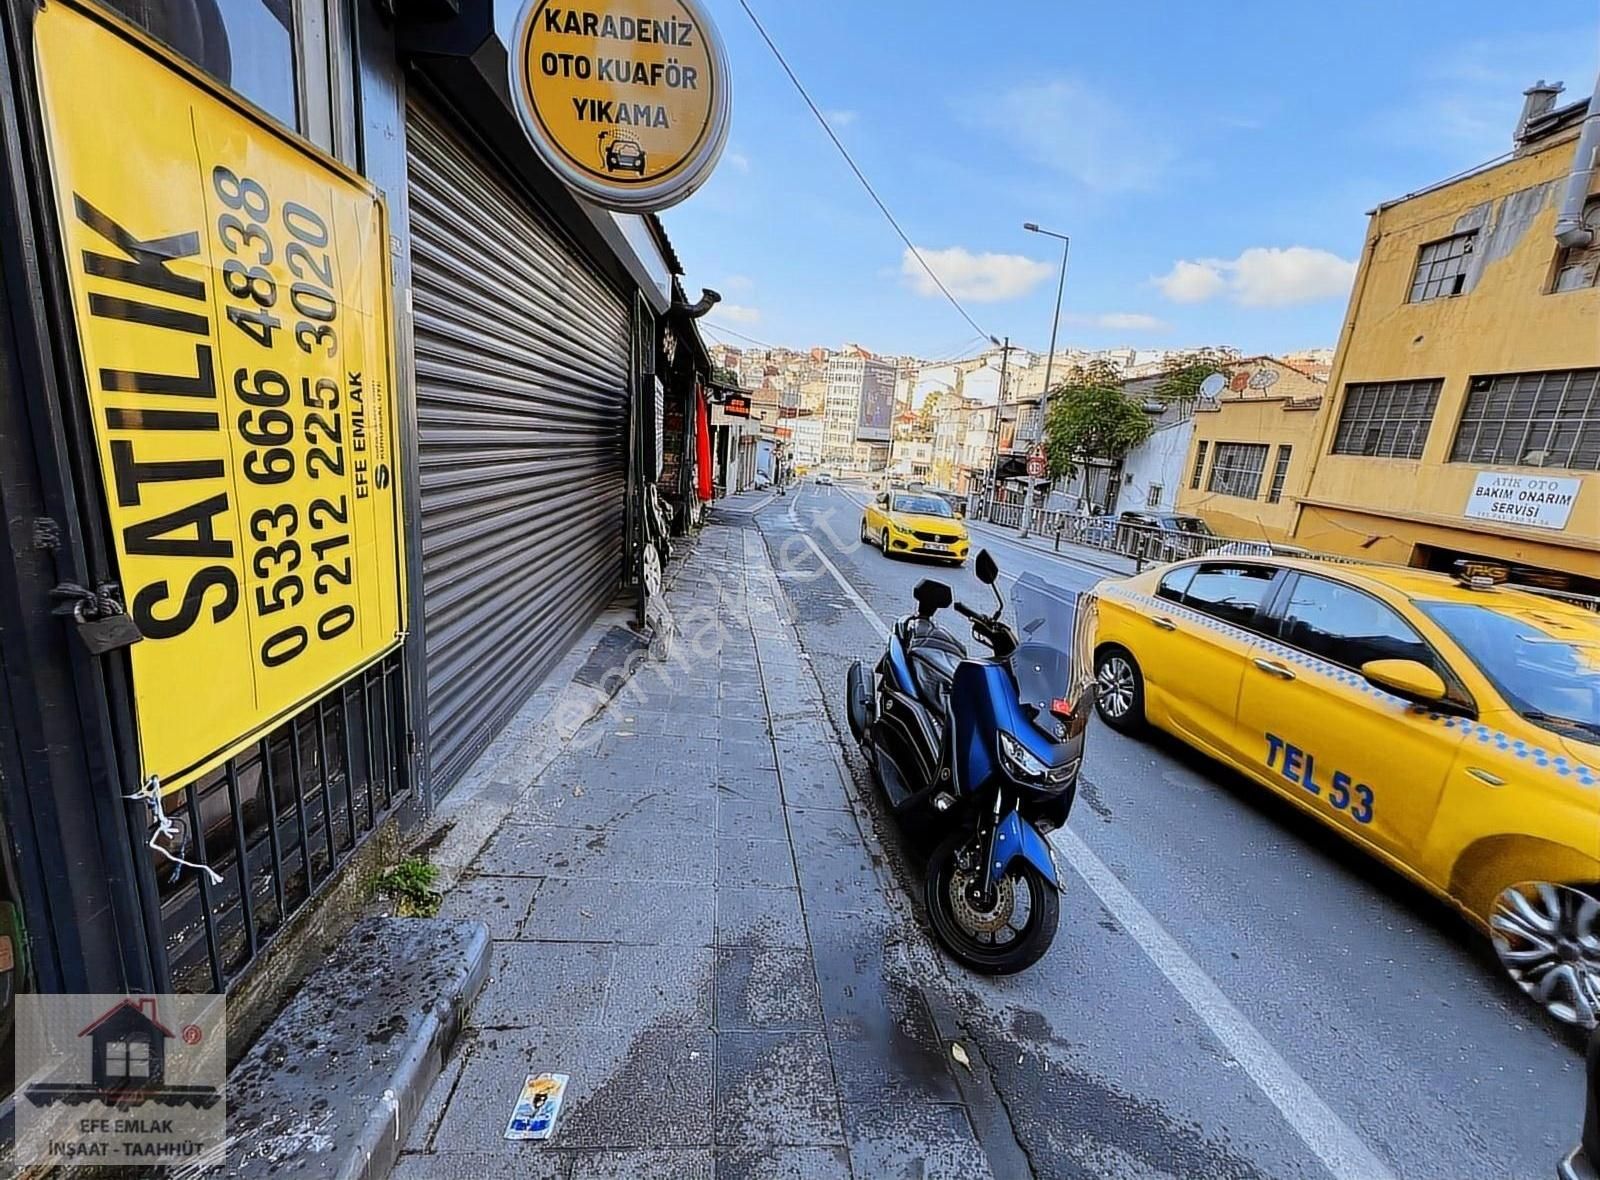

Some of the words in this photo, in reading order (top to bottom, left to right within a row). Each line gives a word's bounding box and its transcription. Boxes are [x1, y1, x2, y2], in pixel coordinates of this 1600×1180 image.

[544, 8, 693, 47] KARADENİZ
[541, 52, 591, 80] OTO
[598, 58, 697, 89] KUAFÖR
[572, 97, 669, 129] YIKAMA
[212, 165, 282, 349] 4838
[282, 201, 339, 358] 3020
[73, 191, 240, 641] SATILIK
[234, 368, 295, 485] 666
[302, 377, 345, 480] 225
[348, 371, 366, 452] EMLAK
[355, 459, 369, 498] EFE
[1475, 486, 1513, 499] BAKIM
[1519, 491, 1572, 506] ONARIM
[1528, 480, 1558, 491] OTO
[1491, 502, 1540, 518] SERVİSİ
[250, 503, 303, 616] 533
[308, 494, 352, 599] 212
[261, 625, 308, 668] 0
[317, 604, 355, 642] 0
[1265, 732, 1320, 795] TEL
[1329, 770, 1374, 824] 53
